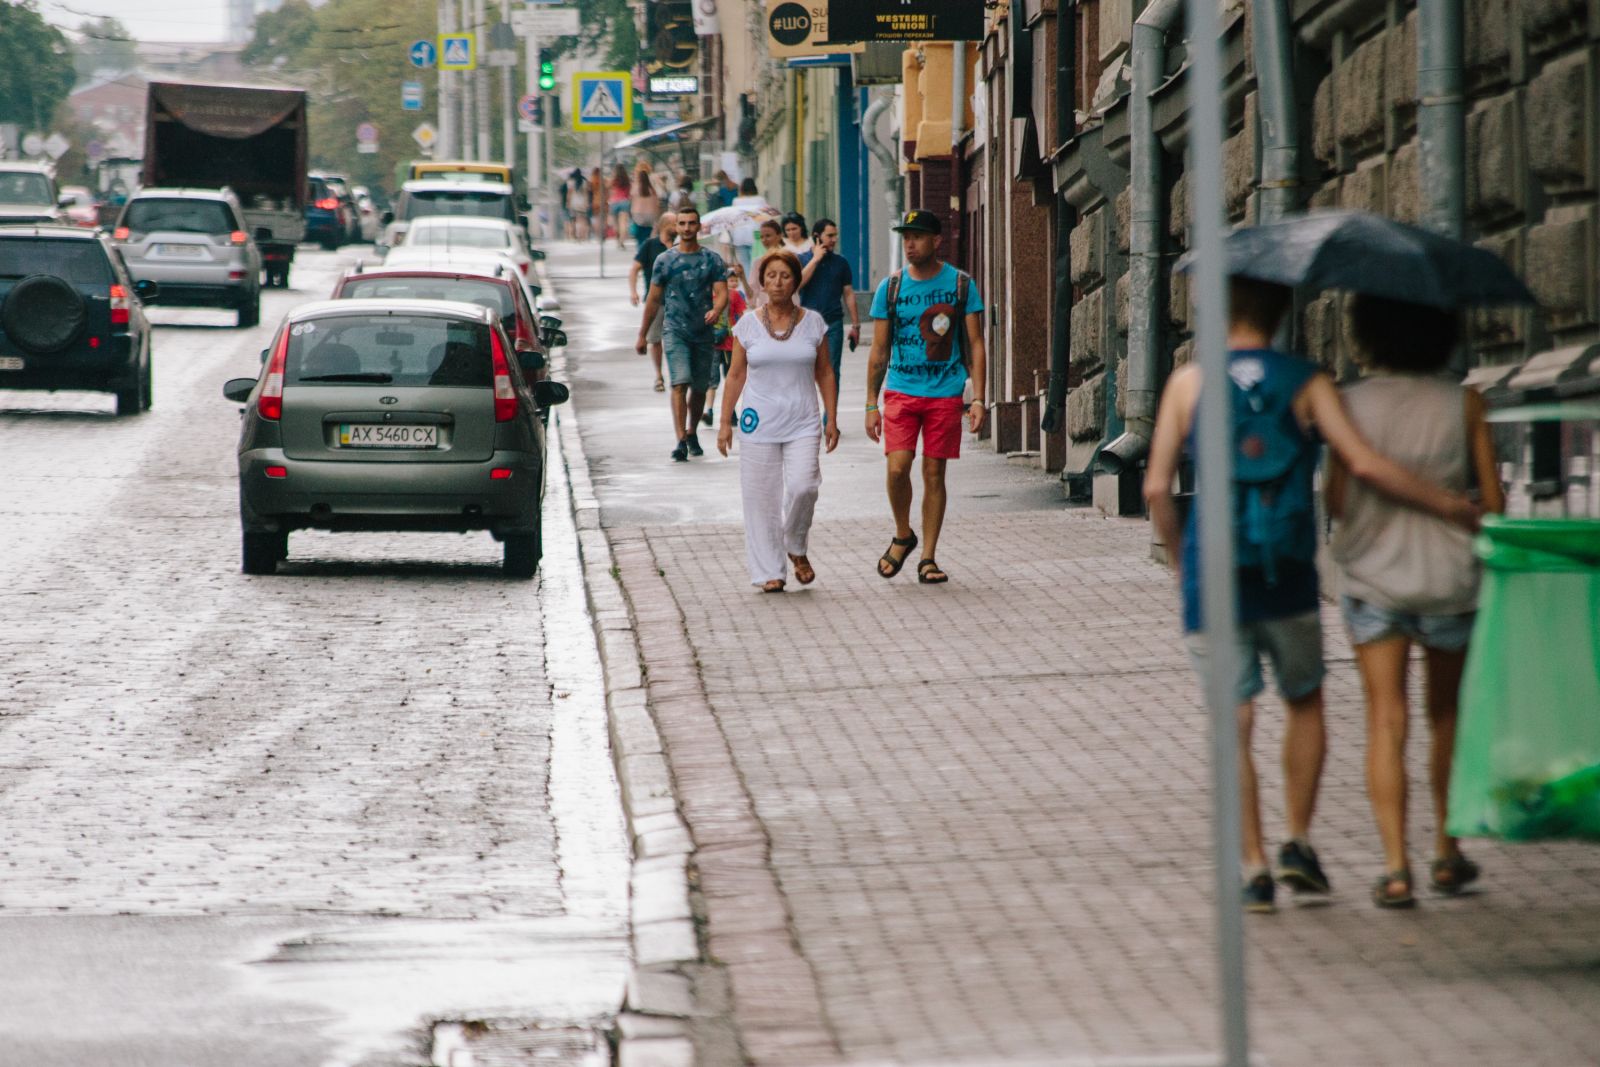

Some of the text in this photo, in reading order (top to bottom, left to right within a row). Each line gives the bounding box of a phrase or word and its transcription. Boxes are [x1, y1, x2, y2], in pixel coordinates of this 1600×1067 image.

[773, 16, 809, 31] #ШО
[876, 14, 926, 22] WESTERN
[891, 22, 926, 30] UNION
[897, 294, 921, 306] HO
[352, 426, 433, 442] AX 5460 CX
